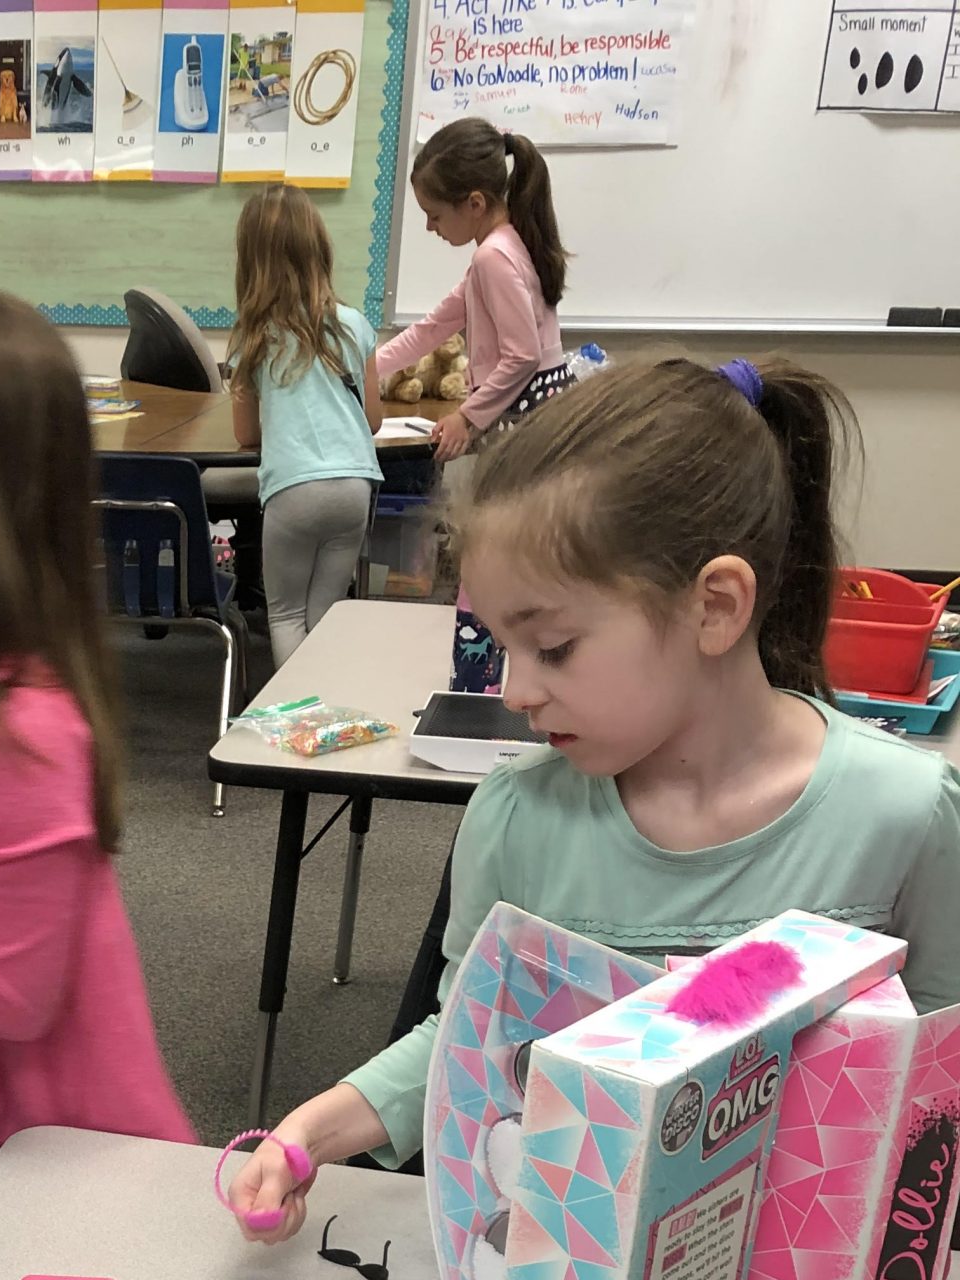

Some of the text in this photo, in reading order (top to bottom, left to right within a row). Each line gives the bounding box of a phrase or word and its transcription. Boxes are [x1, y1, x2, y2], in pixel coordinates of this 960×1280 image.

[473, 17, 487, 35] is
[493, 14, 524, 35] here
[839, 14, 928, 33] Small moment
[455, 38, 476, 63] Be
[481, 36, 557, 65] respectful,
[560, 34, 580, 56] be
[585, 29, 672, 56] responsible
[454, 67, 473, 87] No
[477, 63, 543, 88] GoNoodle,
[549, 65, 568, 83] no
[564, 98, 659, 129] Henry Hudson
[57, 134, 71, 146] wh
[117, 135, 136, 147] a_e
[181, 135, 194, 148] ph
[247, 135, 266, 148] e_e
[310, 141, 330, 153] o_e
[663, 1104, 700, 1143] DISCO
